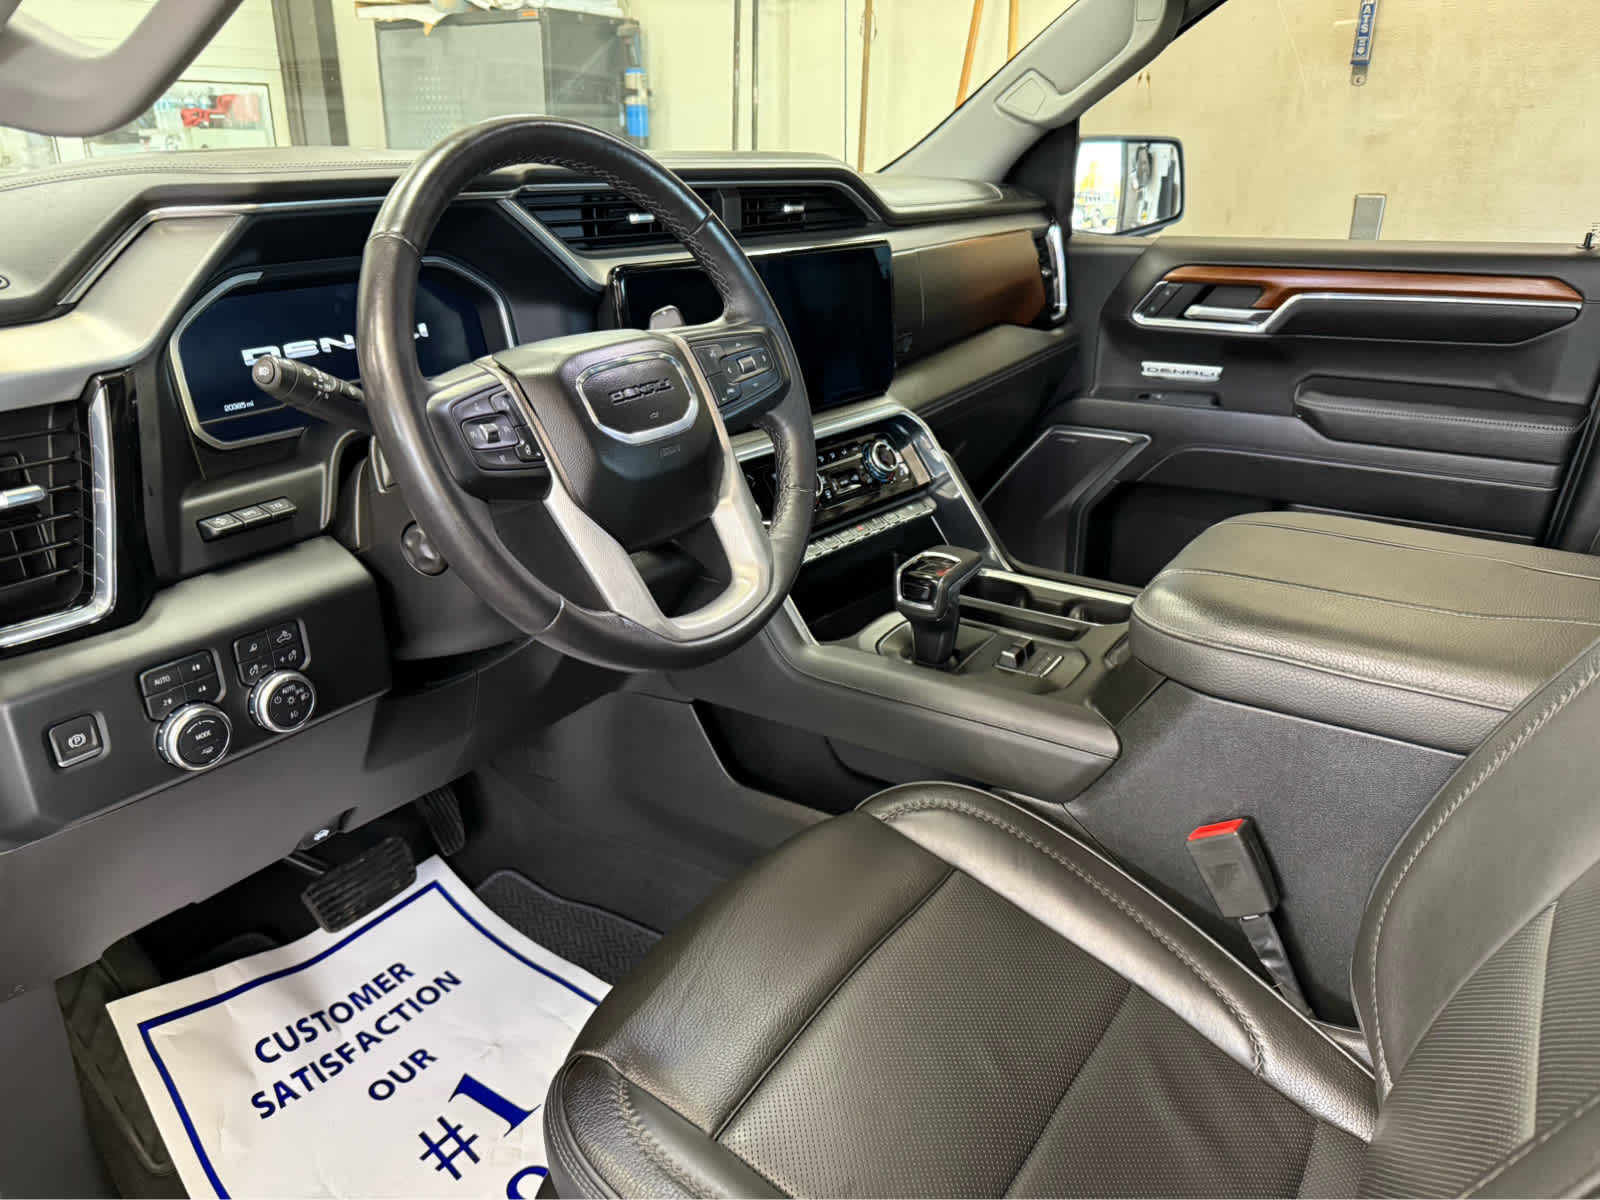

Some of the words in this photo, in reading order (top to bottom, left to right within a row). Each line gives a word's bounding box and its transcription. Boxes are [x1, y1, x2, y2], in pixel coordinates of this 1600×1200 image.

[241, 322, 430, 367] DENI
[154, 674, 171, 686] AUTO
[282, 684, 297, 695] AUTO
[195, 729, 212, 741] MODE
[255, 962, 416, 1063] CUSTOMER
[251, 970, 462, 1119] SATISFACTION
[368, 1048, 438, 1101] OUR
[418, 1073, 541, 1180] #1
